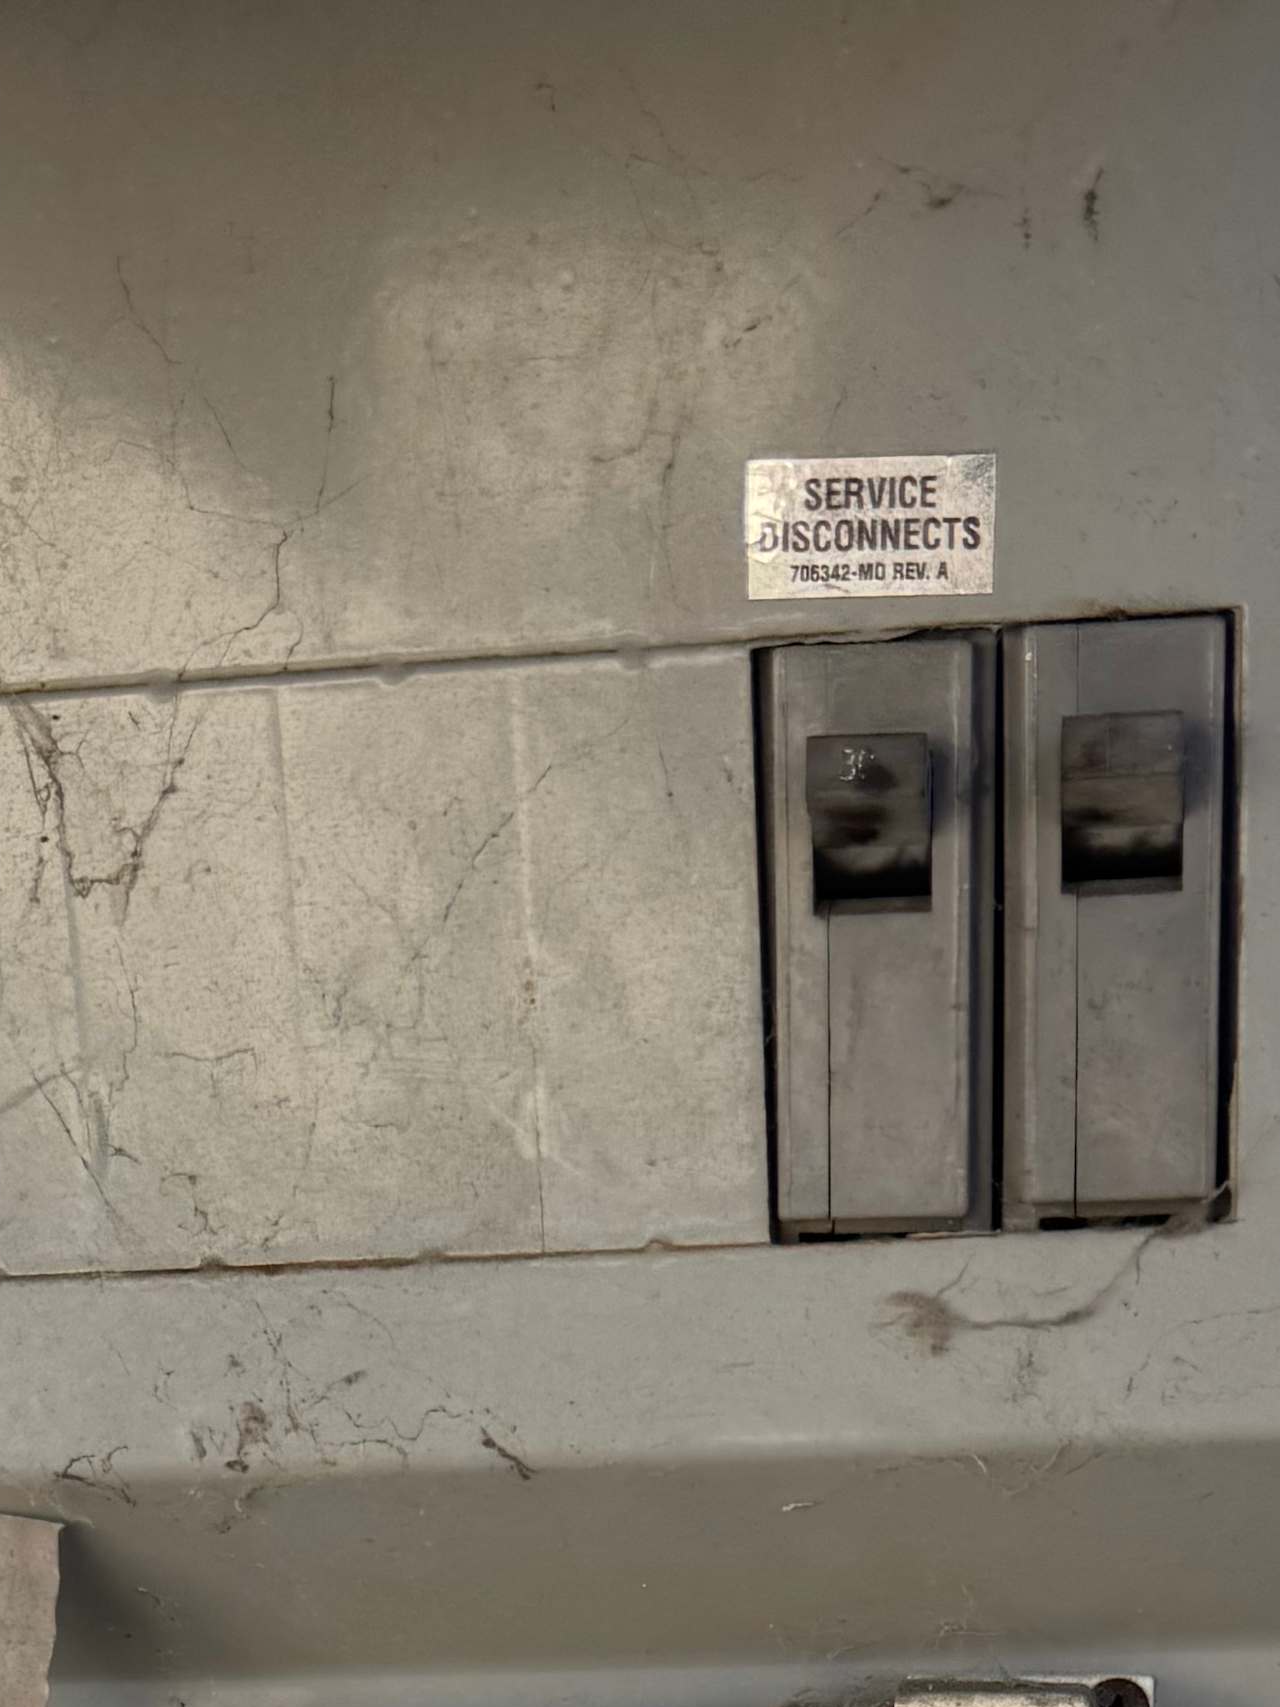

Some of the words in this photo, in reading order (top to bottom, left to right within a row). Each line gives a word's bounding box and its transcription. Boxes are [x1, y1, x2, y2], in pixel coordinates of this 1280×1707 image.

[804, 475, 938, 511] SERVICE
[758, 516, 981, 553] DISCONNECTS
[892, 562, 930, 581] REV.
[937, 561, 949, 580] A
